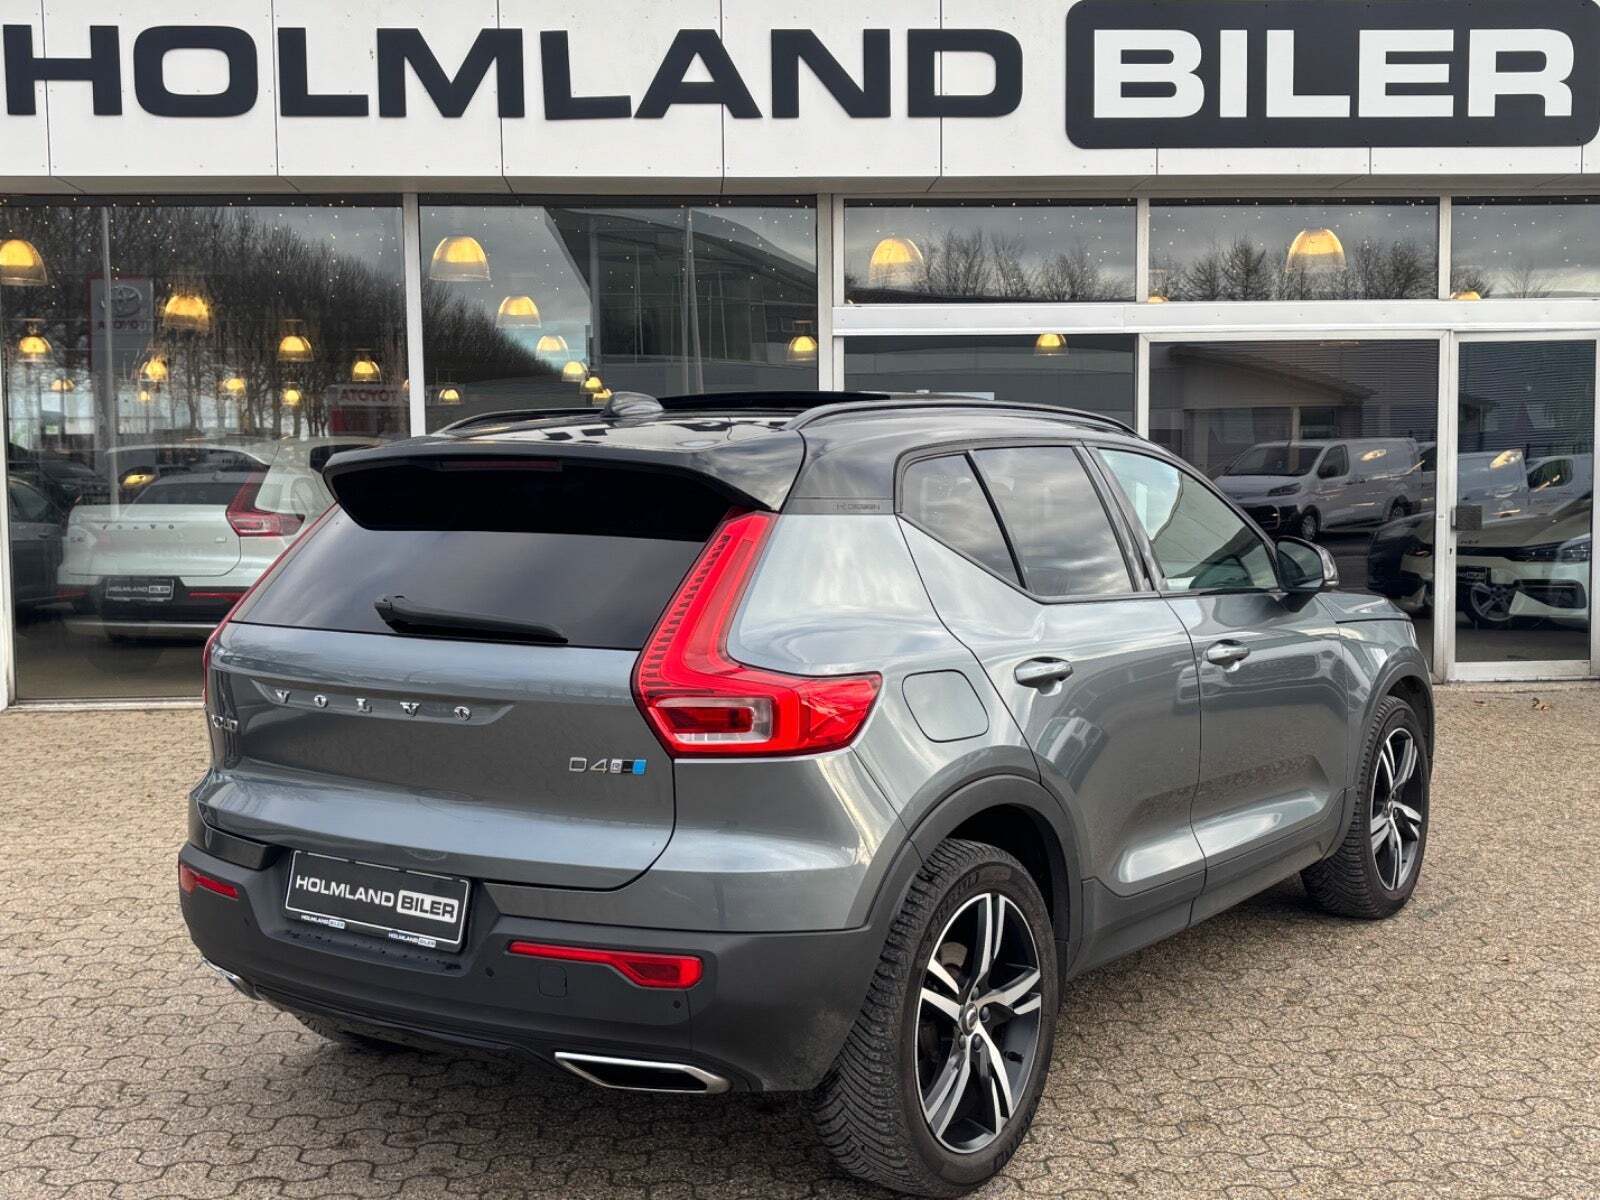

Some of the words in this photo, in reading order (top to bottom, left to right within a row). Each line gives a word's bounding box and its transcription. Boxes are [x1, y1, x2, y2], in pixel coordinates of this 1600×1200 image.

[4, 25, 1022, 120] HOLMLAND
[1094, 29, 1574, 118] BILER
[275, 689, 472, 721] VOLVO
[296, 875, 394, 907] HOLMLAND
[400, 894, 456, 919] BILER
